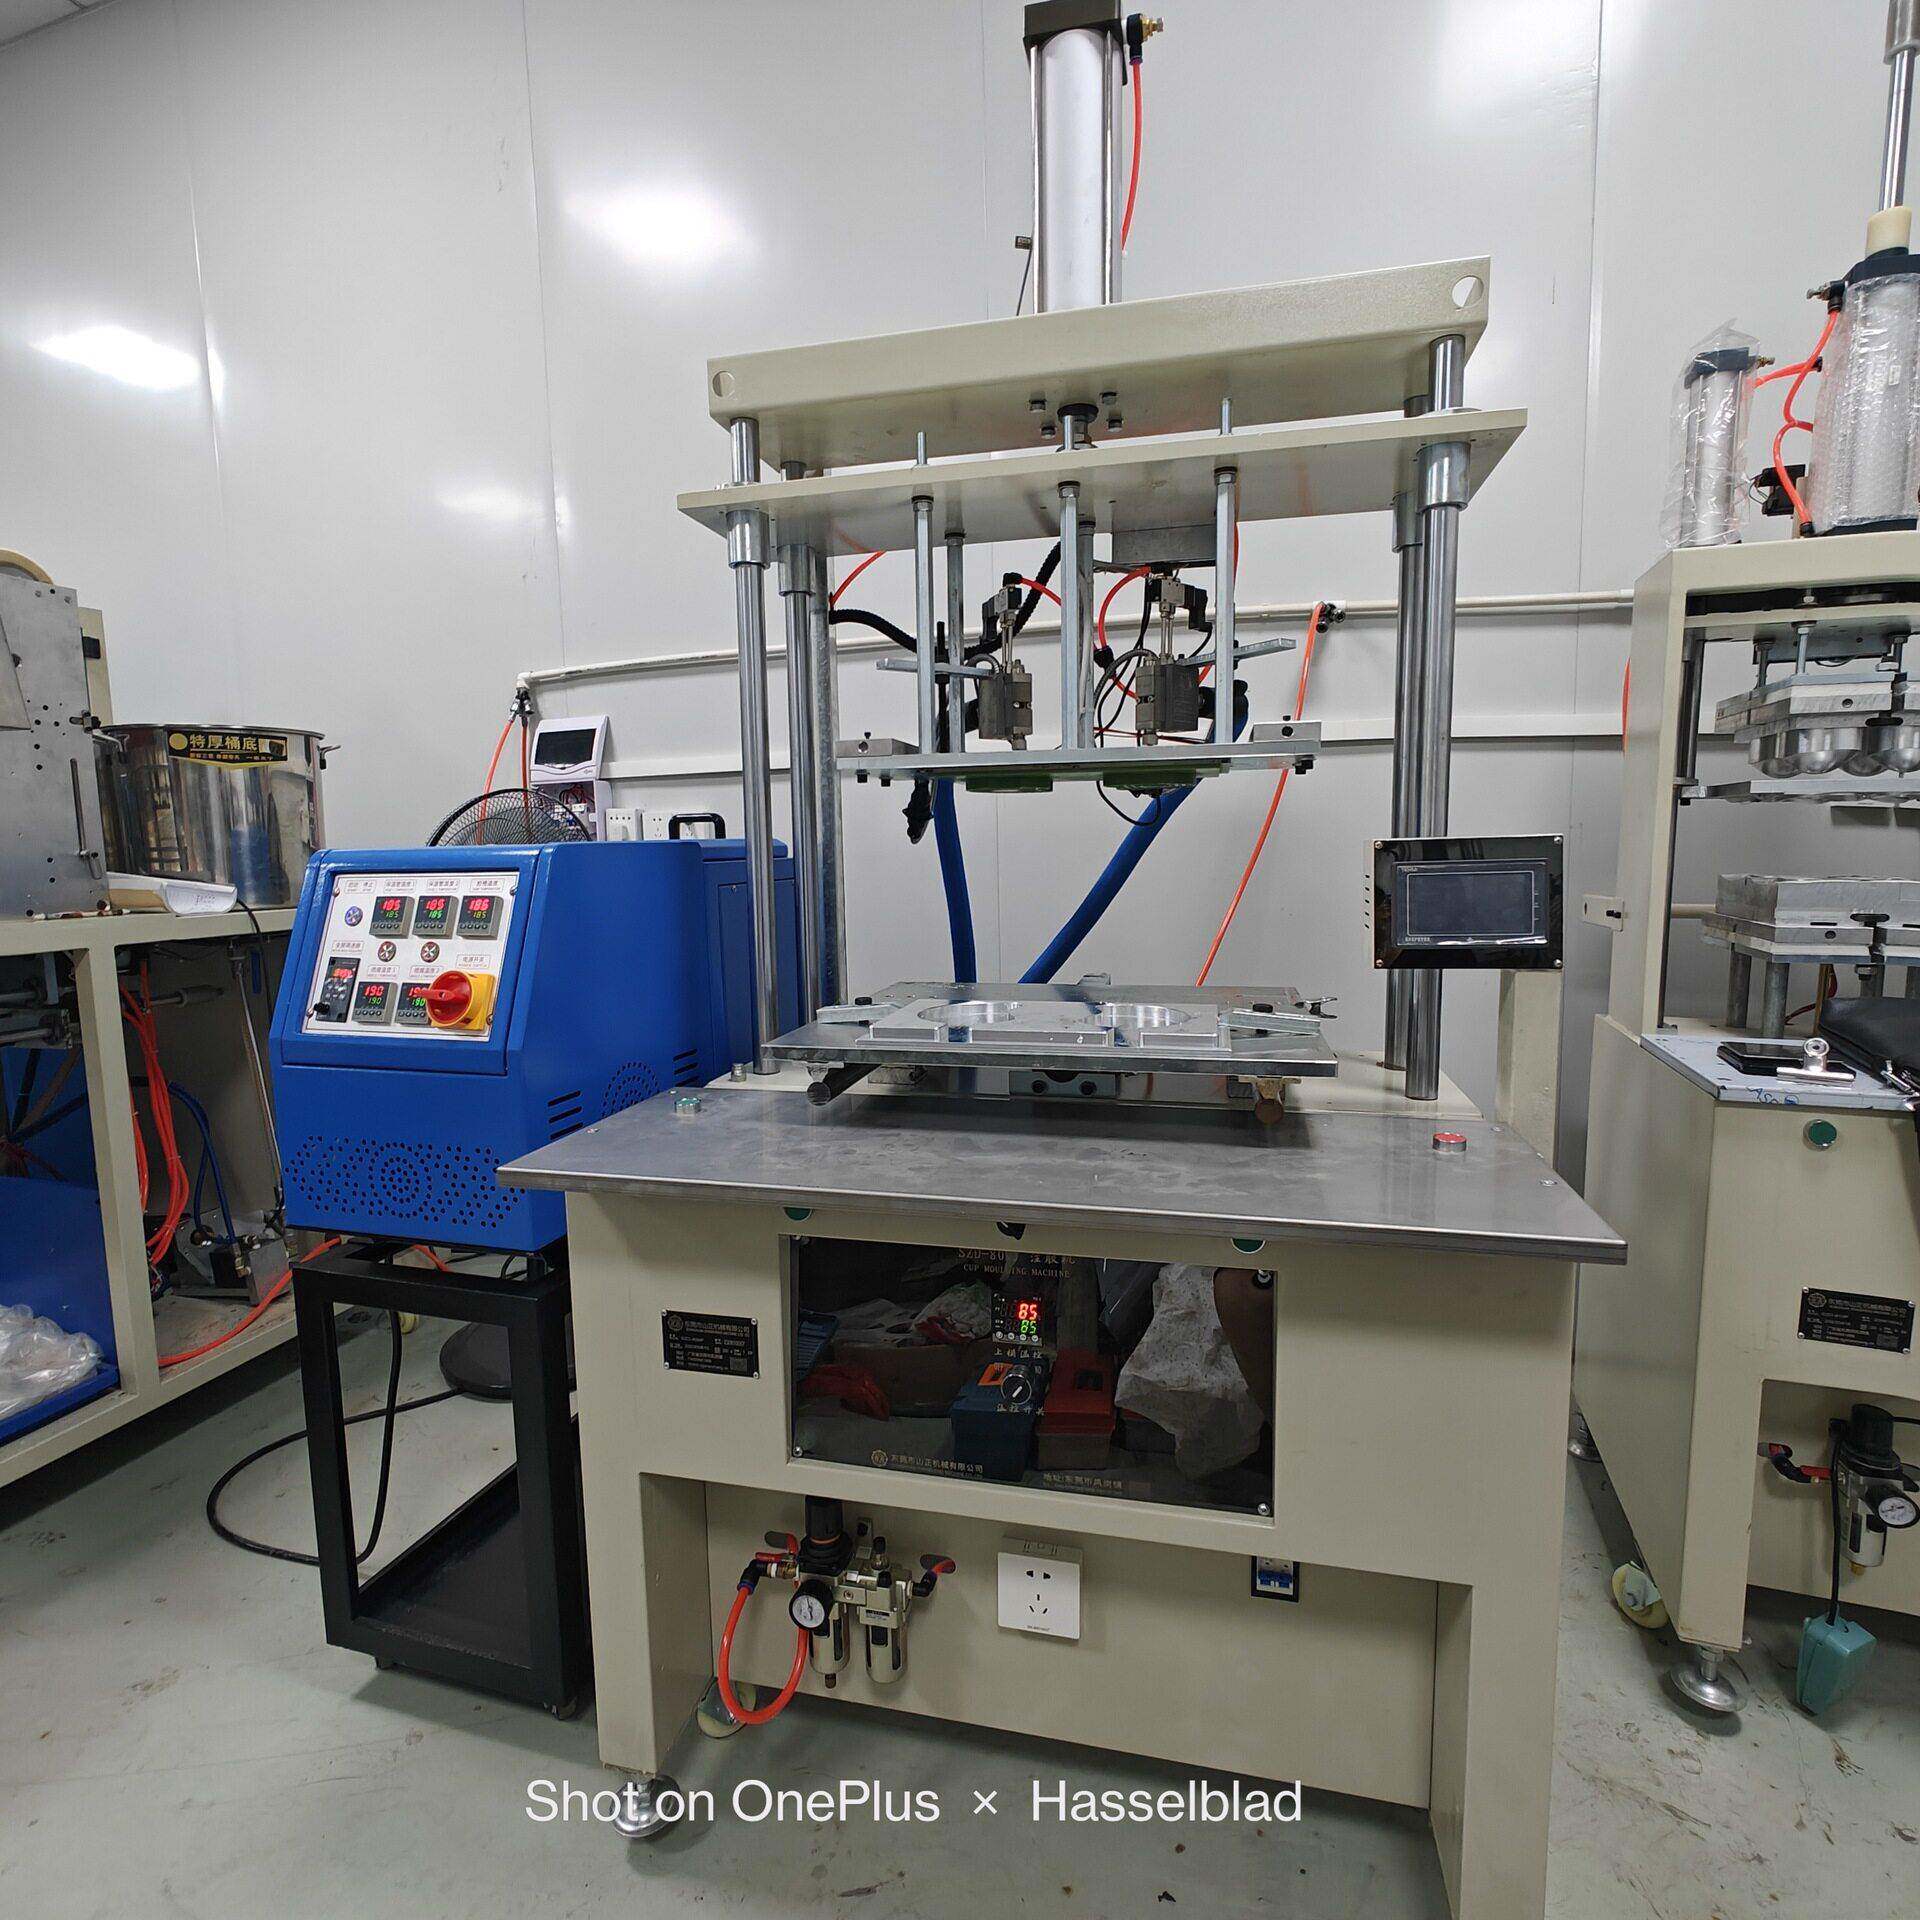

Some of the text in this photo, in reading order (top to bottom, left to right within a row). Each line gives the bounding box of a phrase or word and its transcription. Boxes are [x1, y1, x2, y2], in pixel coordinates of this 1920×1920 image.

[189, 734, 258, 750] 特厚桶底
[365, 986, 384, 997] 190
[368, 997, 381, 1005] 190
[412, 998, 426, 1006] 190
[963, 1264, 1071, 1279] CUP MOULING MACHINE
[1018, 1303, 1038, 1320] 85
[1020, 1320, 1037, 1334] 85
